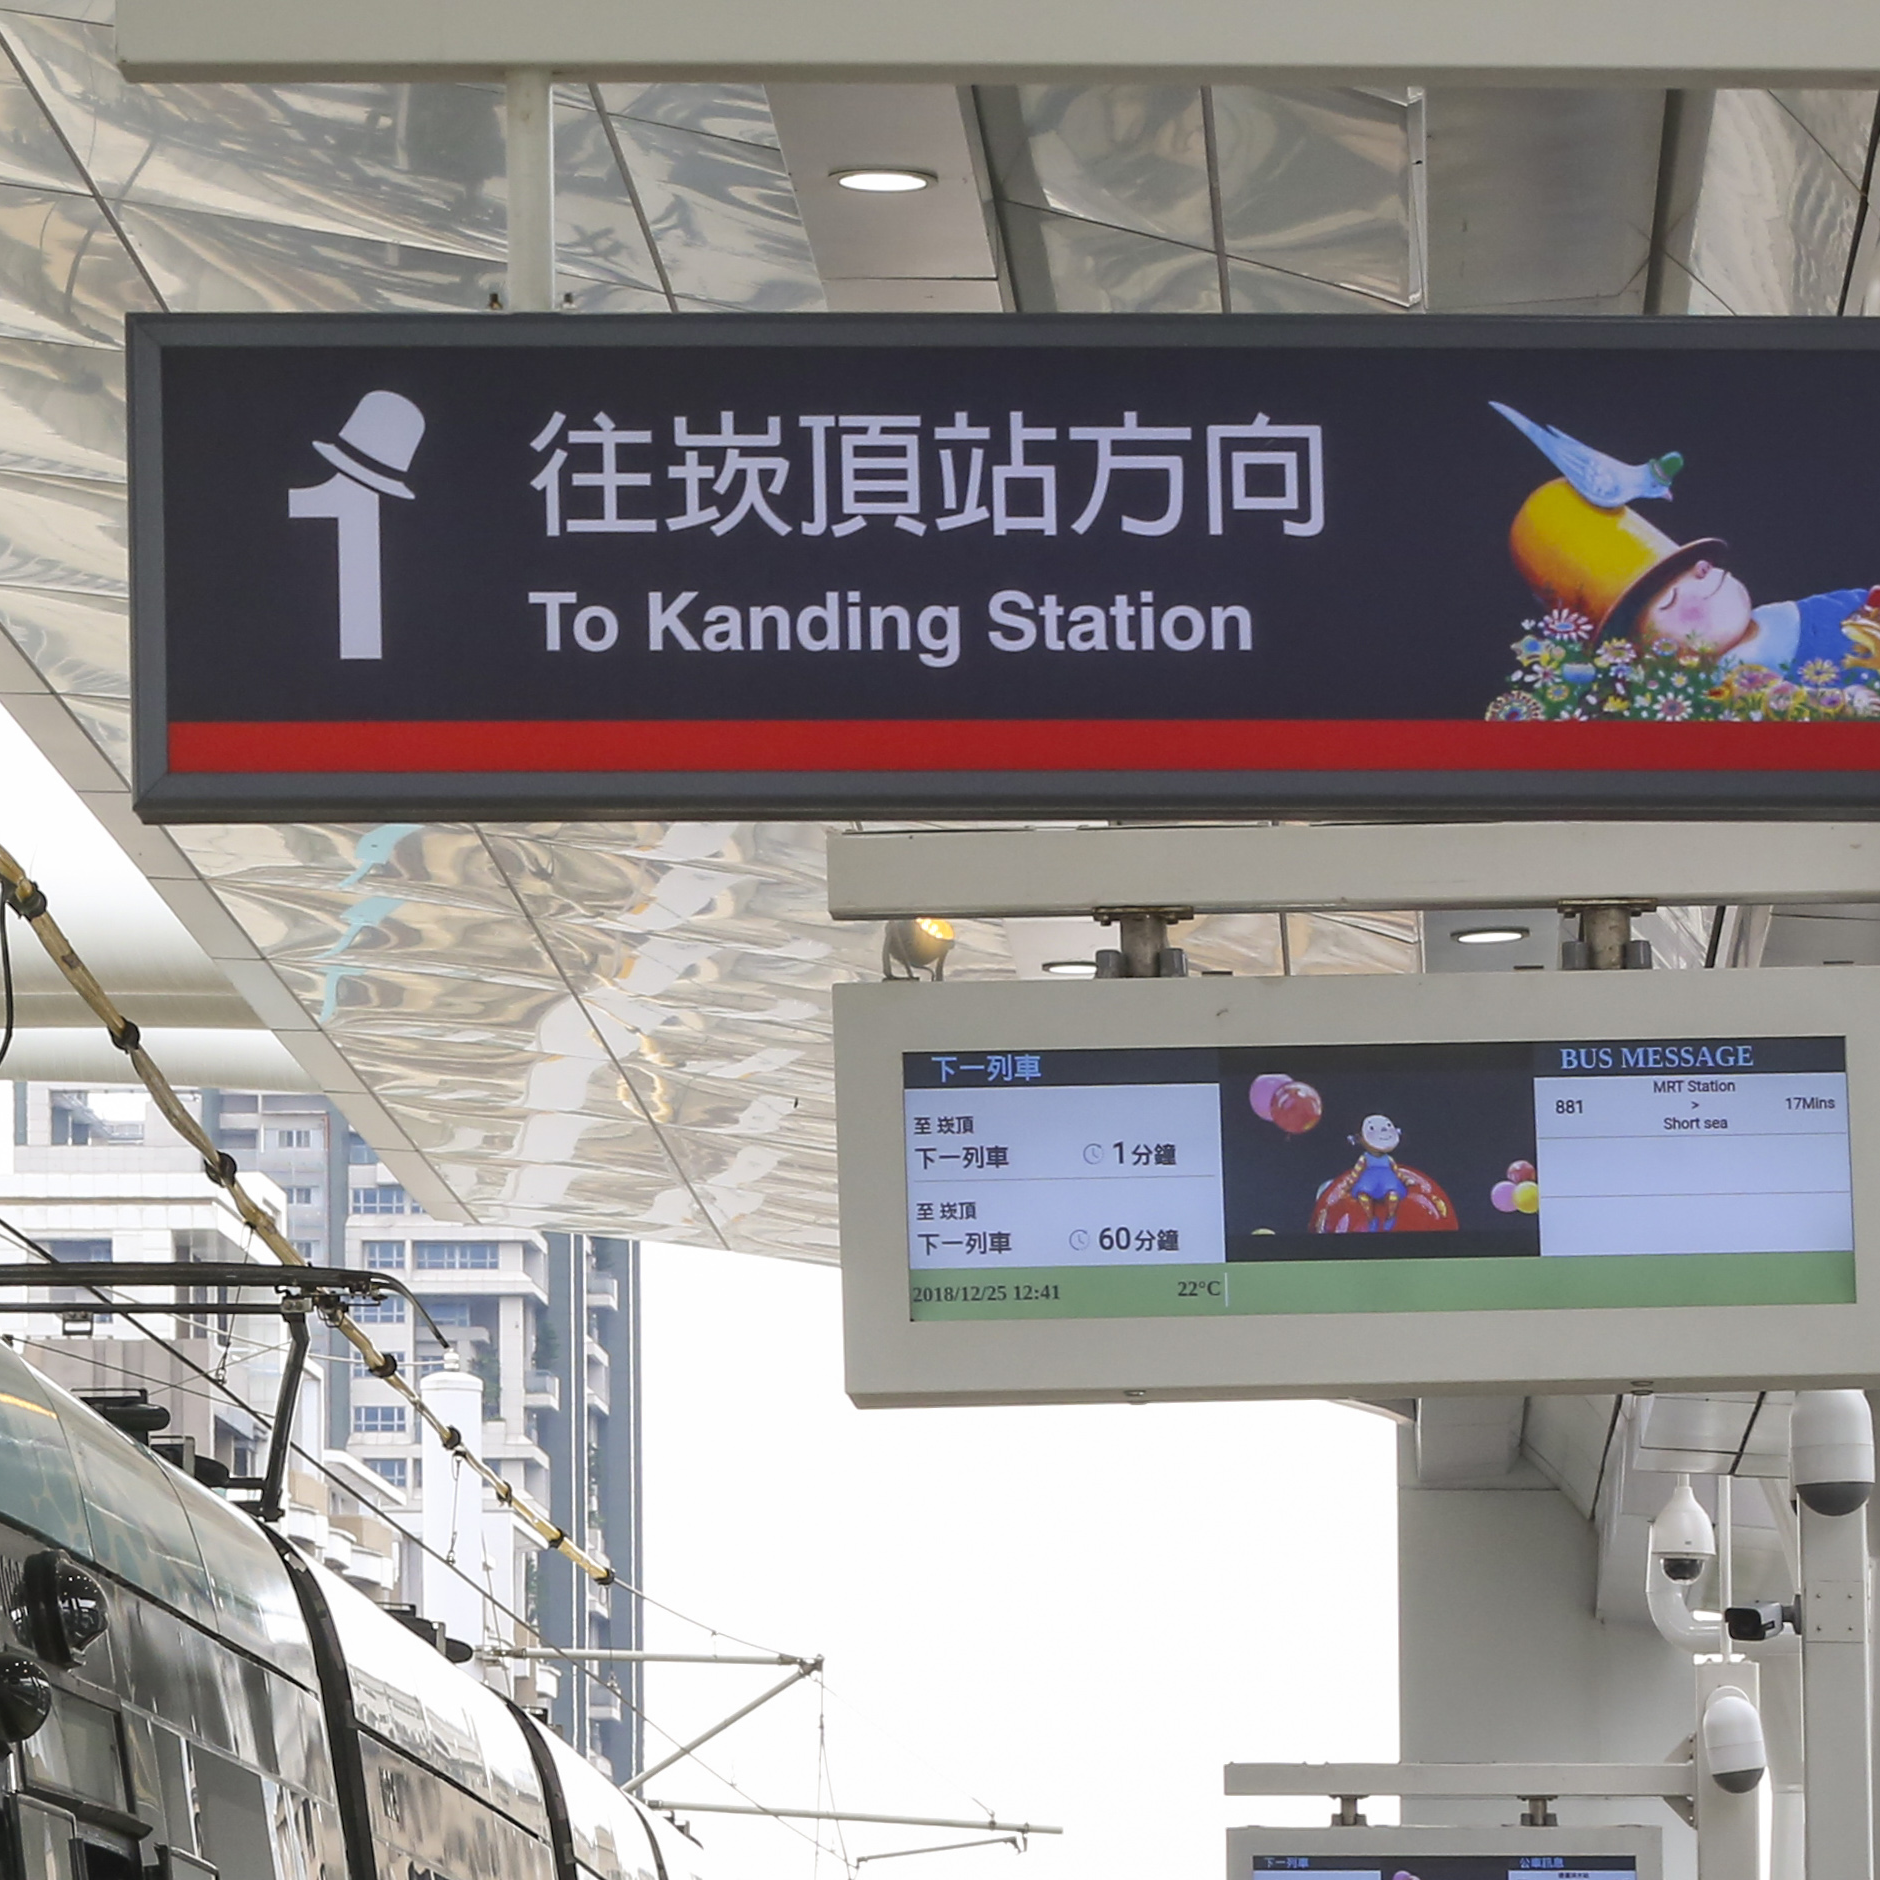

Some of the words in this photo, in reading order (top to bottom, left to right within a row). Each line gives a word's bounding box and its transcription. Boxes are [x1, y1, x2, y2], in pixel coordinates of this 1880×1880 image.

[527, 409, 1326, 540] 往崁頂站方向
[528, 591, 620, 653] To
[647, 590, 962, 668] Kanding
[987, 589, 1254, 653] Station
[1560, 1048, 1613, 1069] BUS
[1621, 1046, 1754, 1068] MESSAGE
[931, 1054, 1041, 1083] 下一列車
[1653, 1080, 1684, 1093] MRT
[1688, 1079, 1736, 1092] Station
[1555, 1100, 1583, 1114] 881
[1785, 1097, 1835, 1111] 17Mins
[914, 1116, 932, 1136] 至
[937, 1115, 974, 1135] 崁頂
[1663, 1117, 1700, 1130] Short
[1705, 1118, 1728, 1130] sea
[915, 1146, 1009, 1170] 下一列車
[917, 1203, 934, 1221] 至
[940, 1202, 977, 1221] 崁頂
[917, 1231, 1012, 1256] 下一列車
[913, 1285, 1007, 1303] 2018/12/25
[1014, 1284, 1060, 1301] 12:41
[1178, 1280, 1221, 1297] 22°C
[1264, 1857, 1309, 1868] 下一列車
